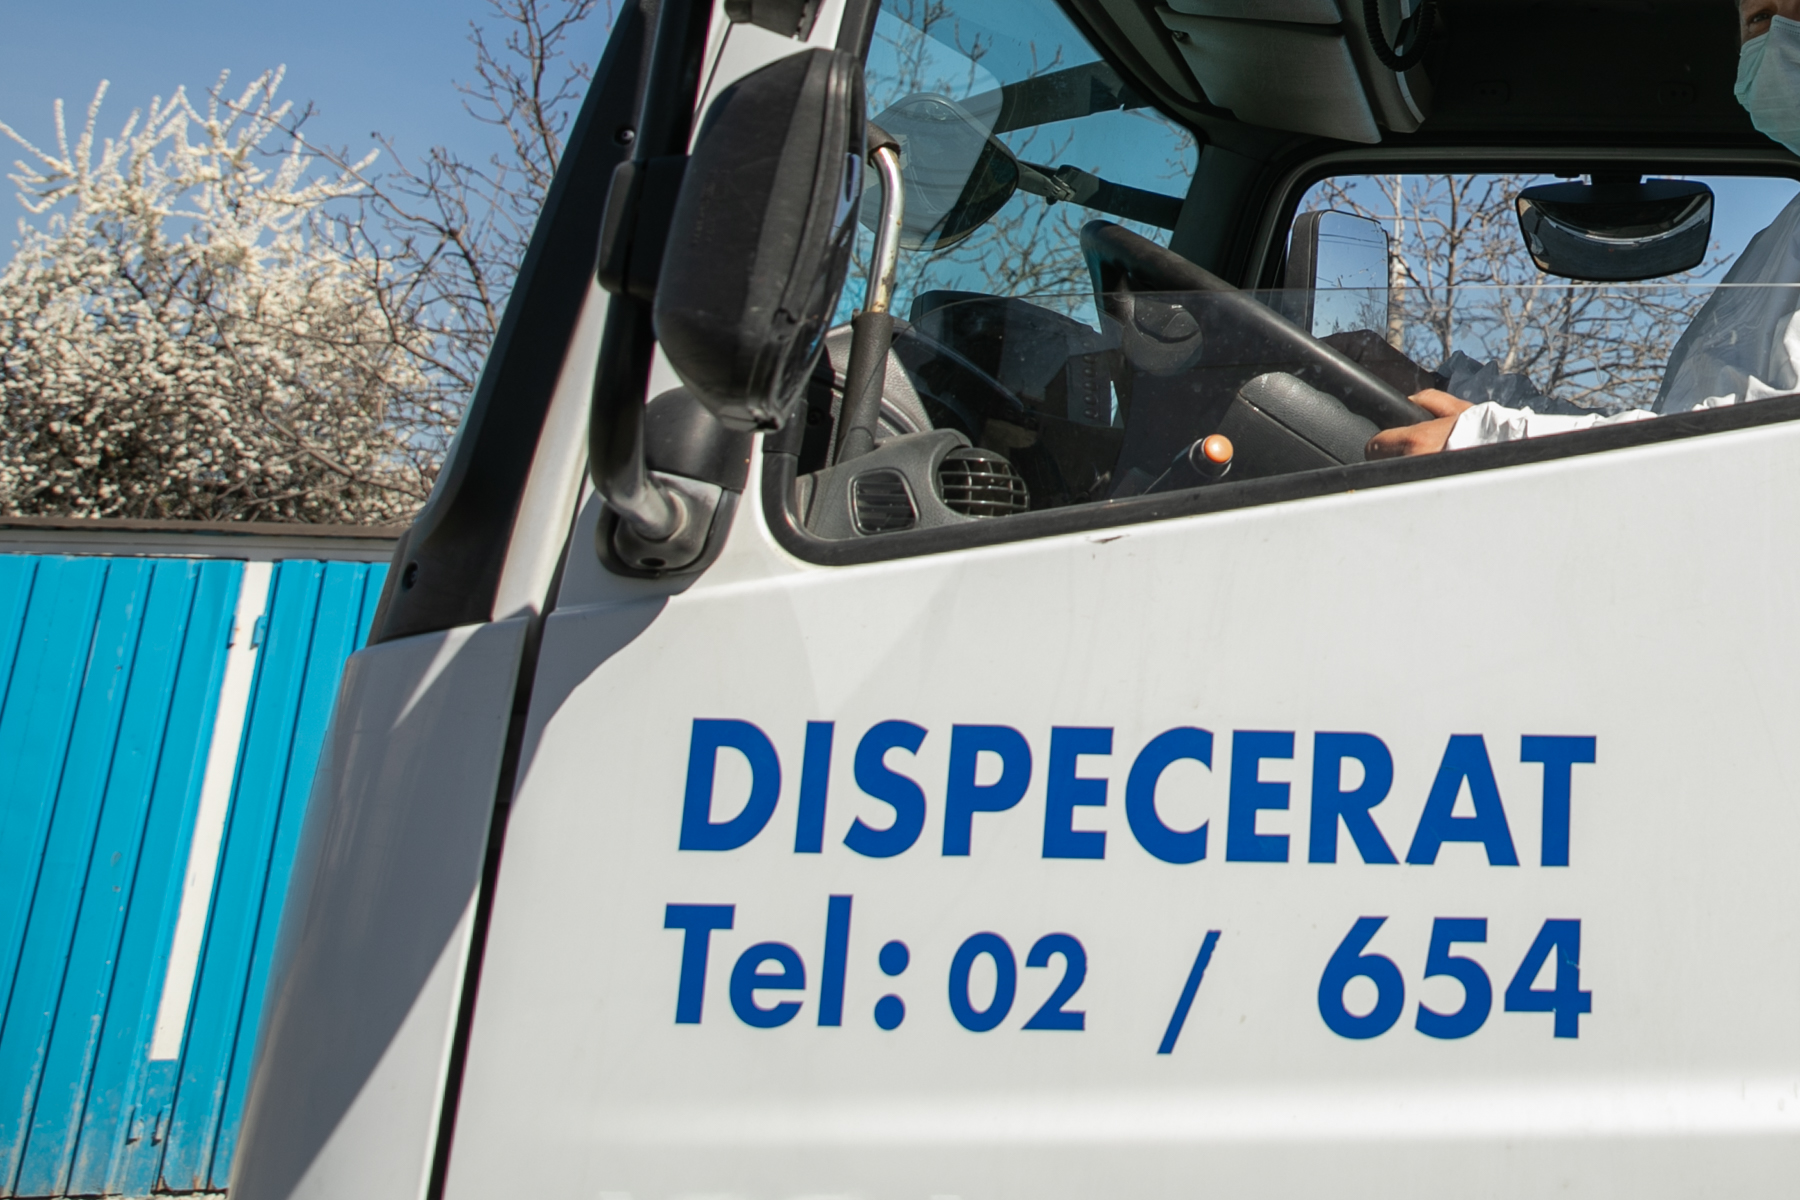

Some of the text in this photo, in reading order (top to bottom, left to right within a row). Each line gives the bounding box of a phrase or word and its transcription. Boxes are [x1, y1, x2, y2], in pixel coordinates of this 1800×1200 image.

[678, 719, 1596, 867] DISPECERAT
[663, 895, 1592, 1055] Tel: 02 / 654
